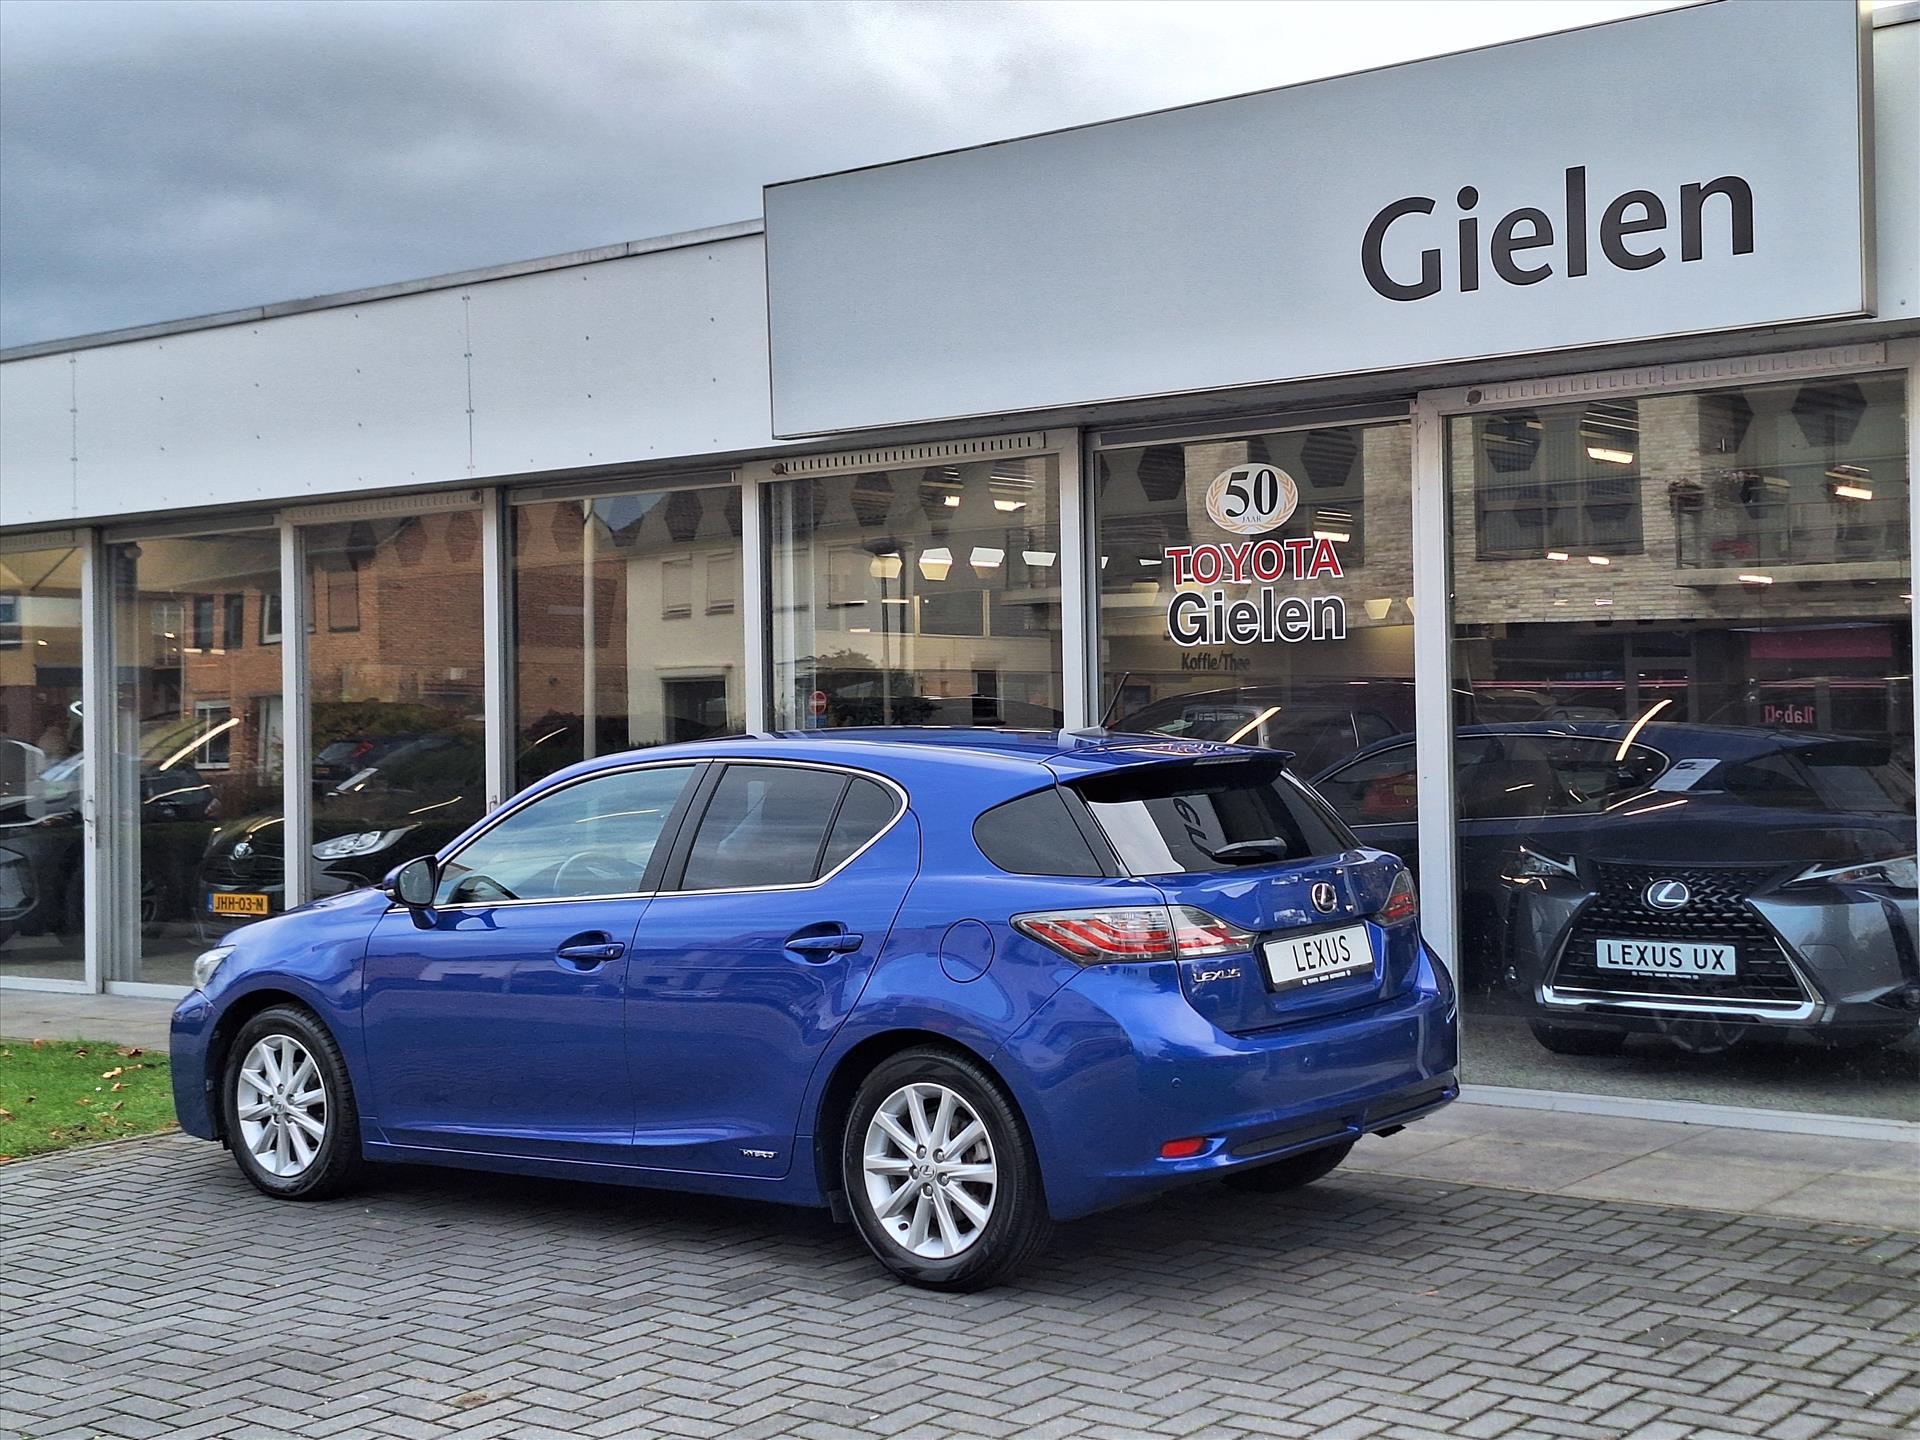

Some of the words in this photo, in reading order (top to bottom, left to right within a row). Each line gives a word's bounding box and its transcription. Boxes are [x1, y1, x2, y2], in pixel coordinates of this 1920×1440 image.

[1361, 165, 1754, 301] Gielen
[1225, 468, 1279, 518] 50
[1165, 537, 1344, 586] TOYOTA
[1168, 586, 1347, 648] Gielen
[215, 896, 264, 911] JHH-03-N
[1292, 935, 1351, 972] LEXUS
[1607, 943, 1682, 968] LEXUS
[1694, 948, 1726, 971] UX
[1193, 968, 1240, 983] LEXUS
